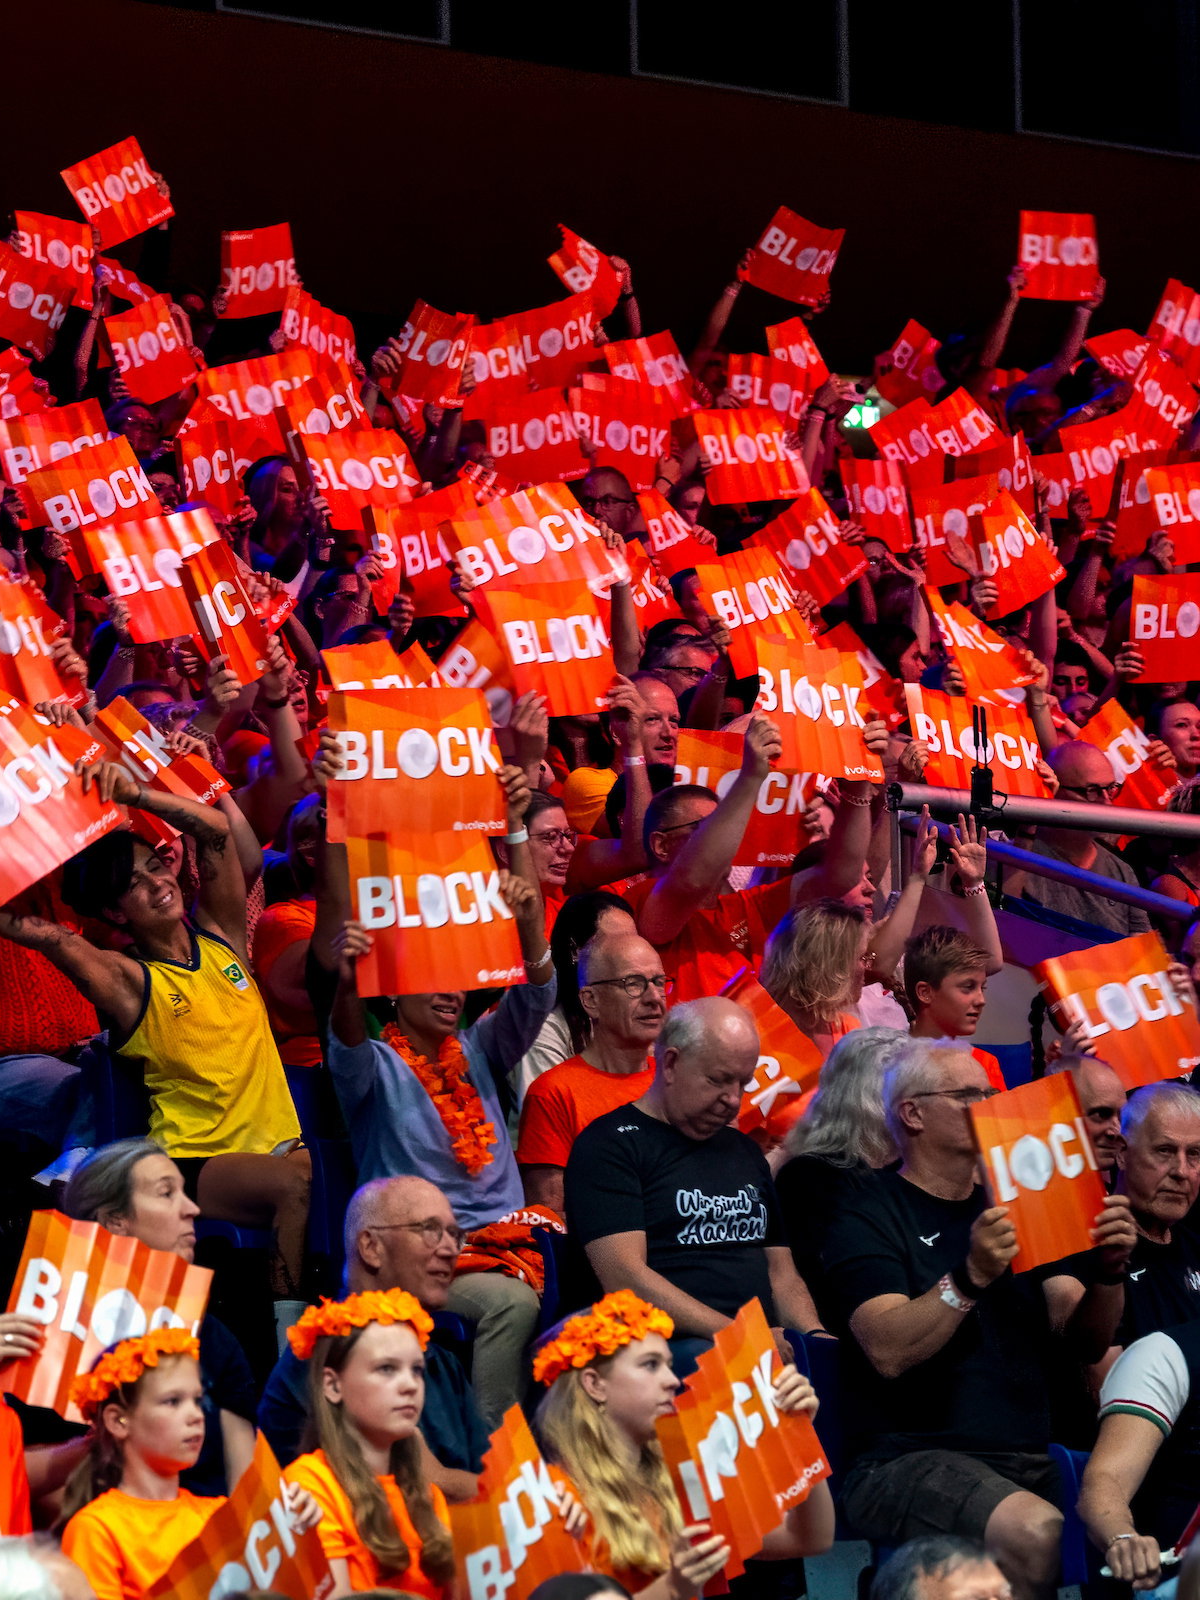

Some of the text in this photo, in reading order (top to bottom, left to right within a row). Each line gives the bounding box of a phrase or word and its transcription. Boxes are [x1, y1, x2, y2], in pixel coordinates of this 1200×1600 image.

[75, 158, 157, 217] BLOCK
[490, 411, 582, 458] BLOCK
[43, 466, 154, 535] BLOCK
[309, 452, 420, 491] BLOCK
[456, 508, 602, 588] BLOCK
[503, 614, 611, 666] BLOCK
[758, 666, 866, 729] BLOCK
[335, 726, 500, 781] BLOCK
[914, 712, 1039, 771] BLOCK
[357, 870, 513, 930] BLOCK
